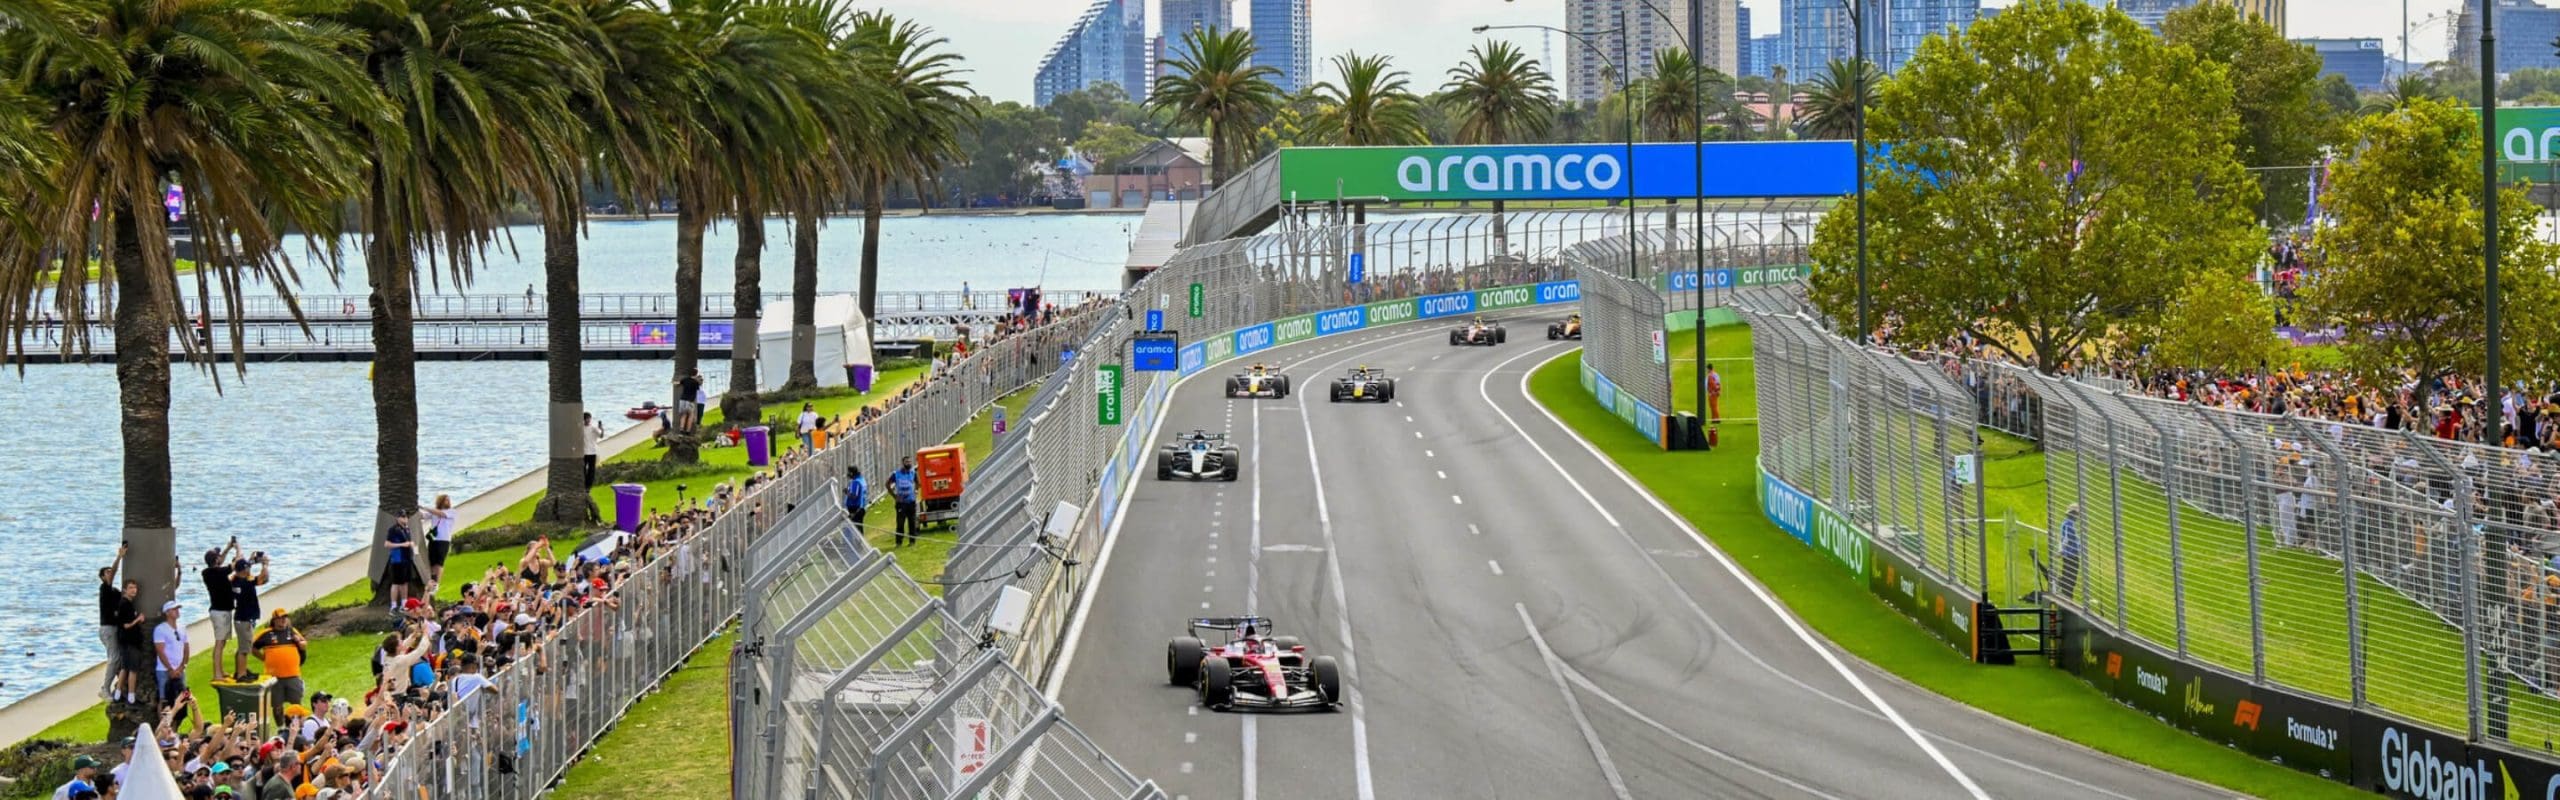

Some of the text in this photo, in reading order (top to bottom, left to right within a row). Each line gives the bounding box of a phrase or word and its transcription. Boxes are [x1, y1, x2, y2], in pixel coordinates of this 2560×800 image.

[1397, 154, 1621, 191] aramco
[1481, 287, 1529, 307] aramco
[1544, 284, 1580, 300] aram
[1370, 301, 1412, 323] aramco
[1424, 294, 1469, 315] aramco
[1277, 318, 1312, 340] aramco
[1321, 309, 1360, 331] aramco
[1239, 327, 1269, 350] aramco
[1136, 346, 1173, 354] aramco
[1768, 482, 1806, 534] aramco
[1819, 511, 1863, 574] aramco
[2288, 716, 2327, 748] Formula
[2381, 727, 2493, 800] Globant
